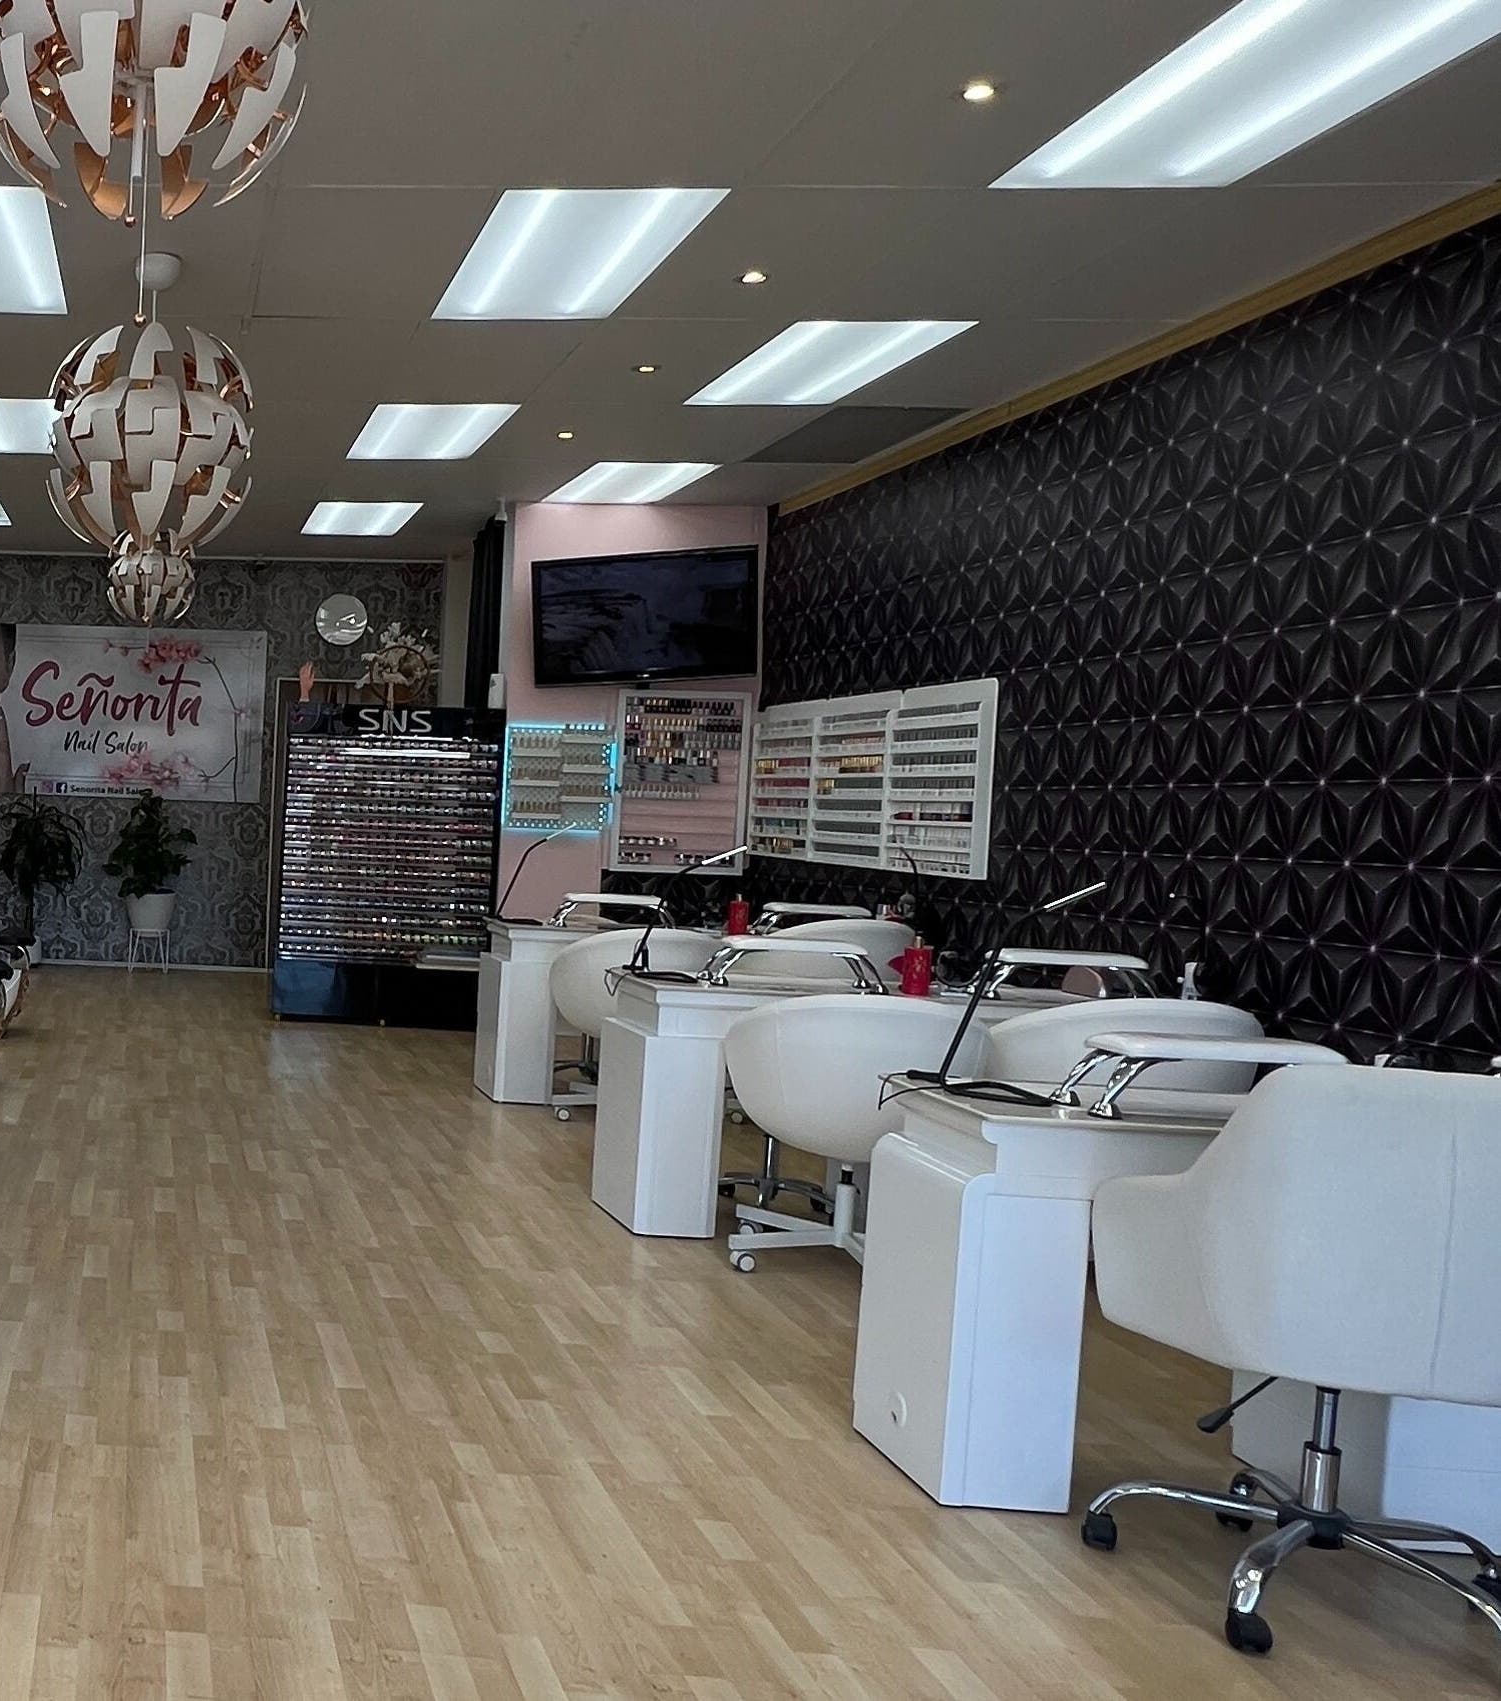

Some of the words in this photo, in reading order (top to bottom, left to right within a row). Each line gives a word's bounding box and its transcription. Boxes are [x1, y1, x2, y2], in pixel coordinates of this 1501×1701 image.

[22, 660, 202, 736] Señorita
[358, 709, 432, 733] SNS
[64, 730, 100, 754] Nail
[105, 731, 148, 754] Salon
